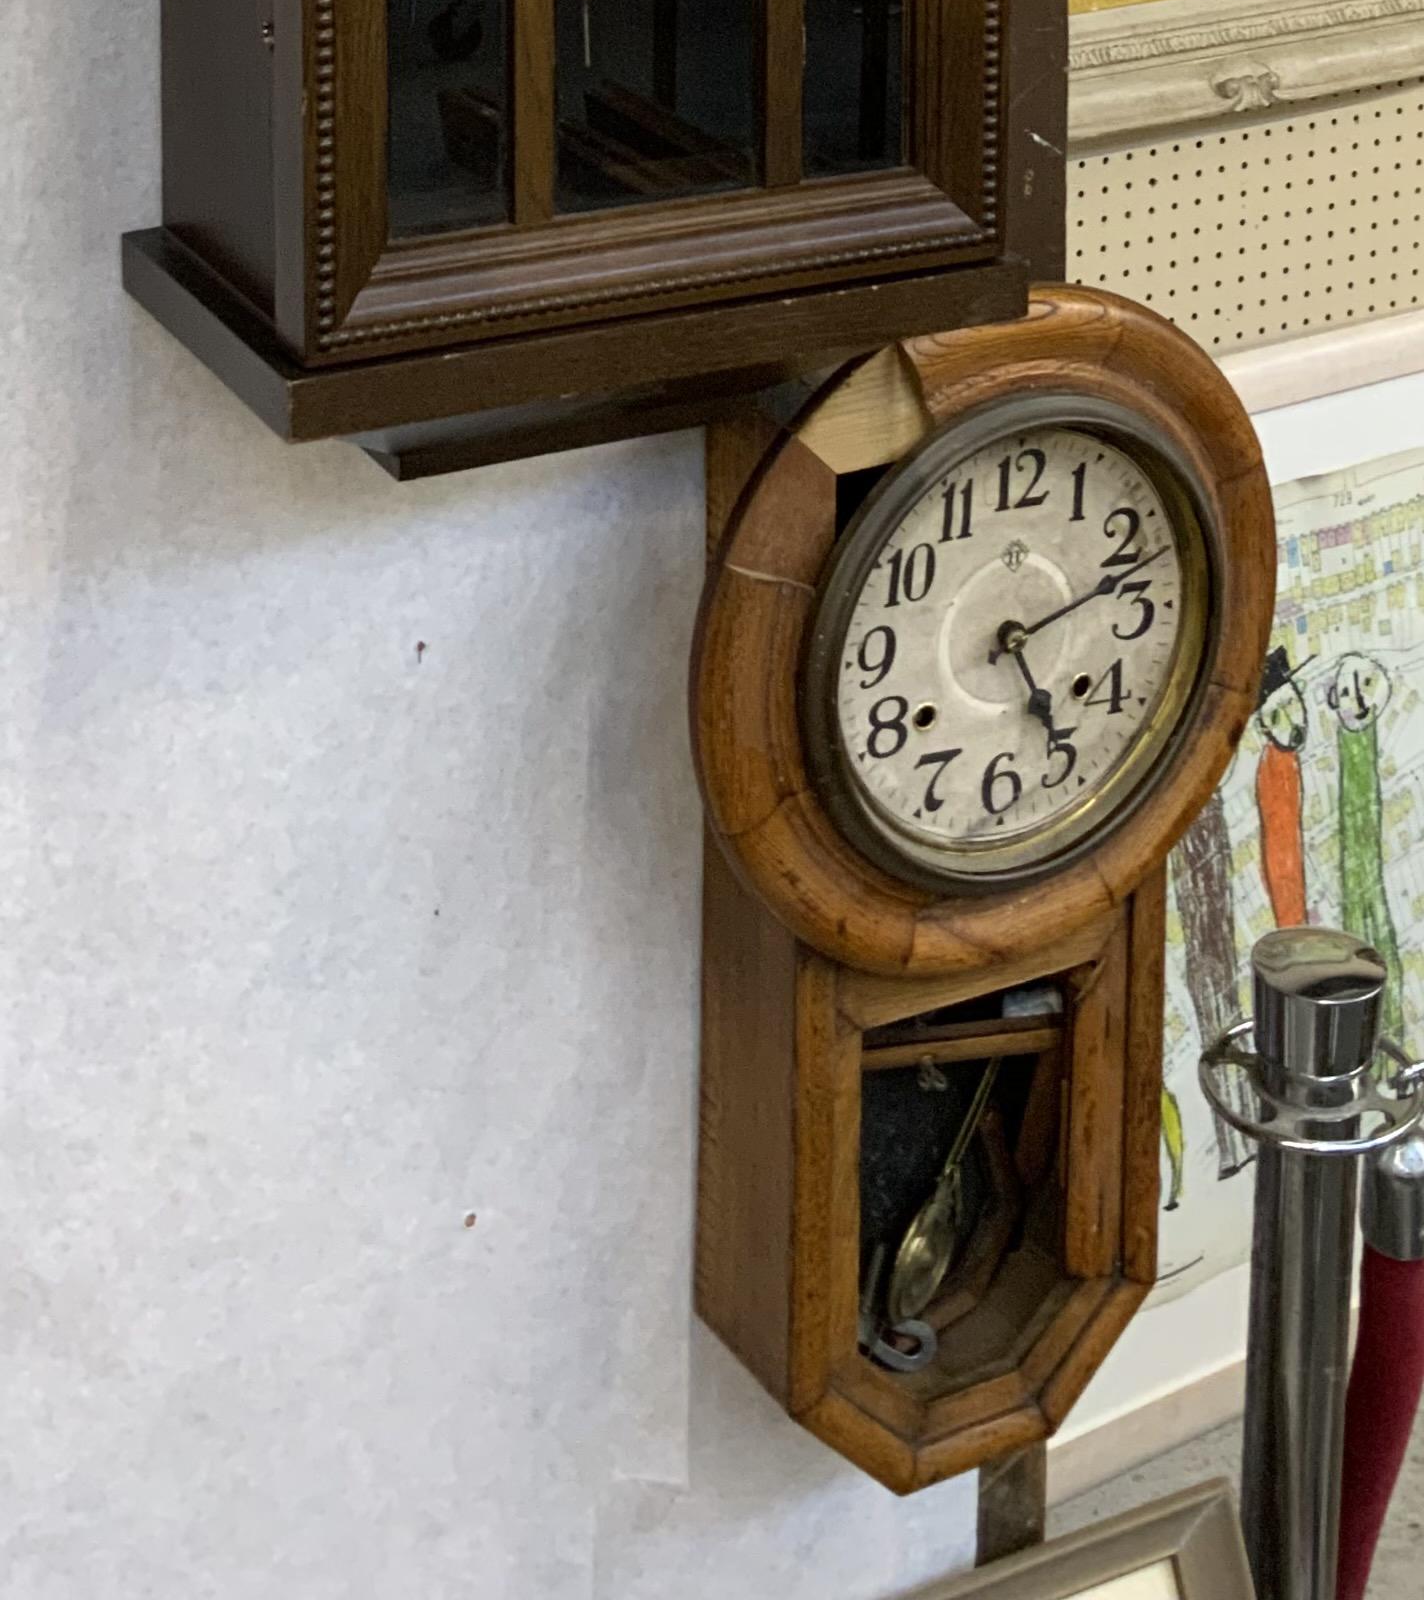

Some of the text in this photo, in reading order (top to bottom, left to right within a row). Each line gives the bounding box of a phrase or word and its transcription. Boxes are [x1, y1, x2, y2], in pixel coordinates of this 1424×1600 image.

[938, 477, 974, 543] 11
[994, 448, 1051, 513] 12
[1069, 462, 1087, 522] 1
[1100, 507, 1142, 569] 2
[883, 542, 936, 608] 10
[1111, 579, 1153, 640] 3
[857, 625, 897, 689] 9
[1083, 658, 1133, 715] 4
[866, 696, 909, 759] 8
[1041, 726, 1078, 789] 5
[913, 747, 963, 813] 7
[982, 751, 1022, 814] 6
